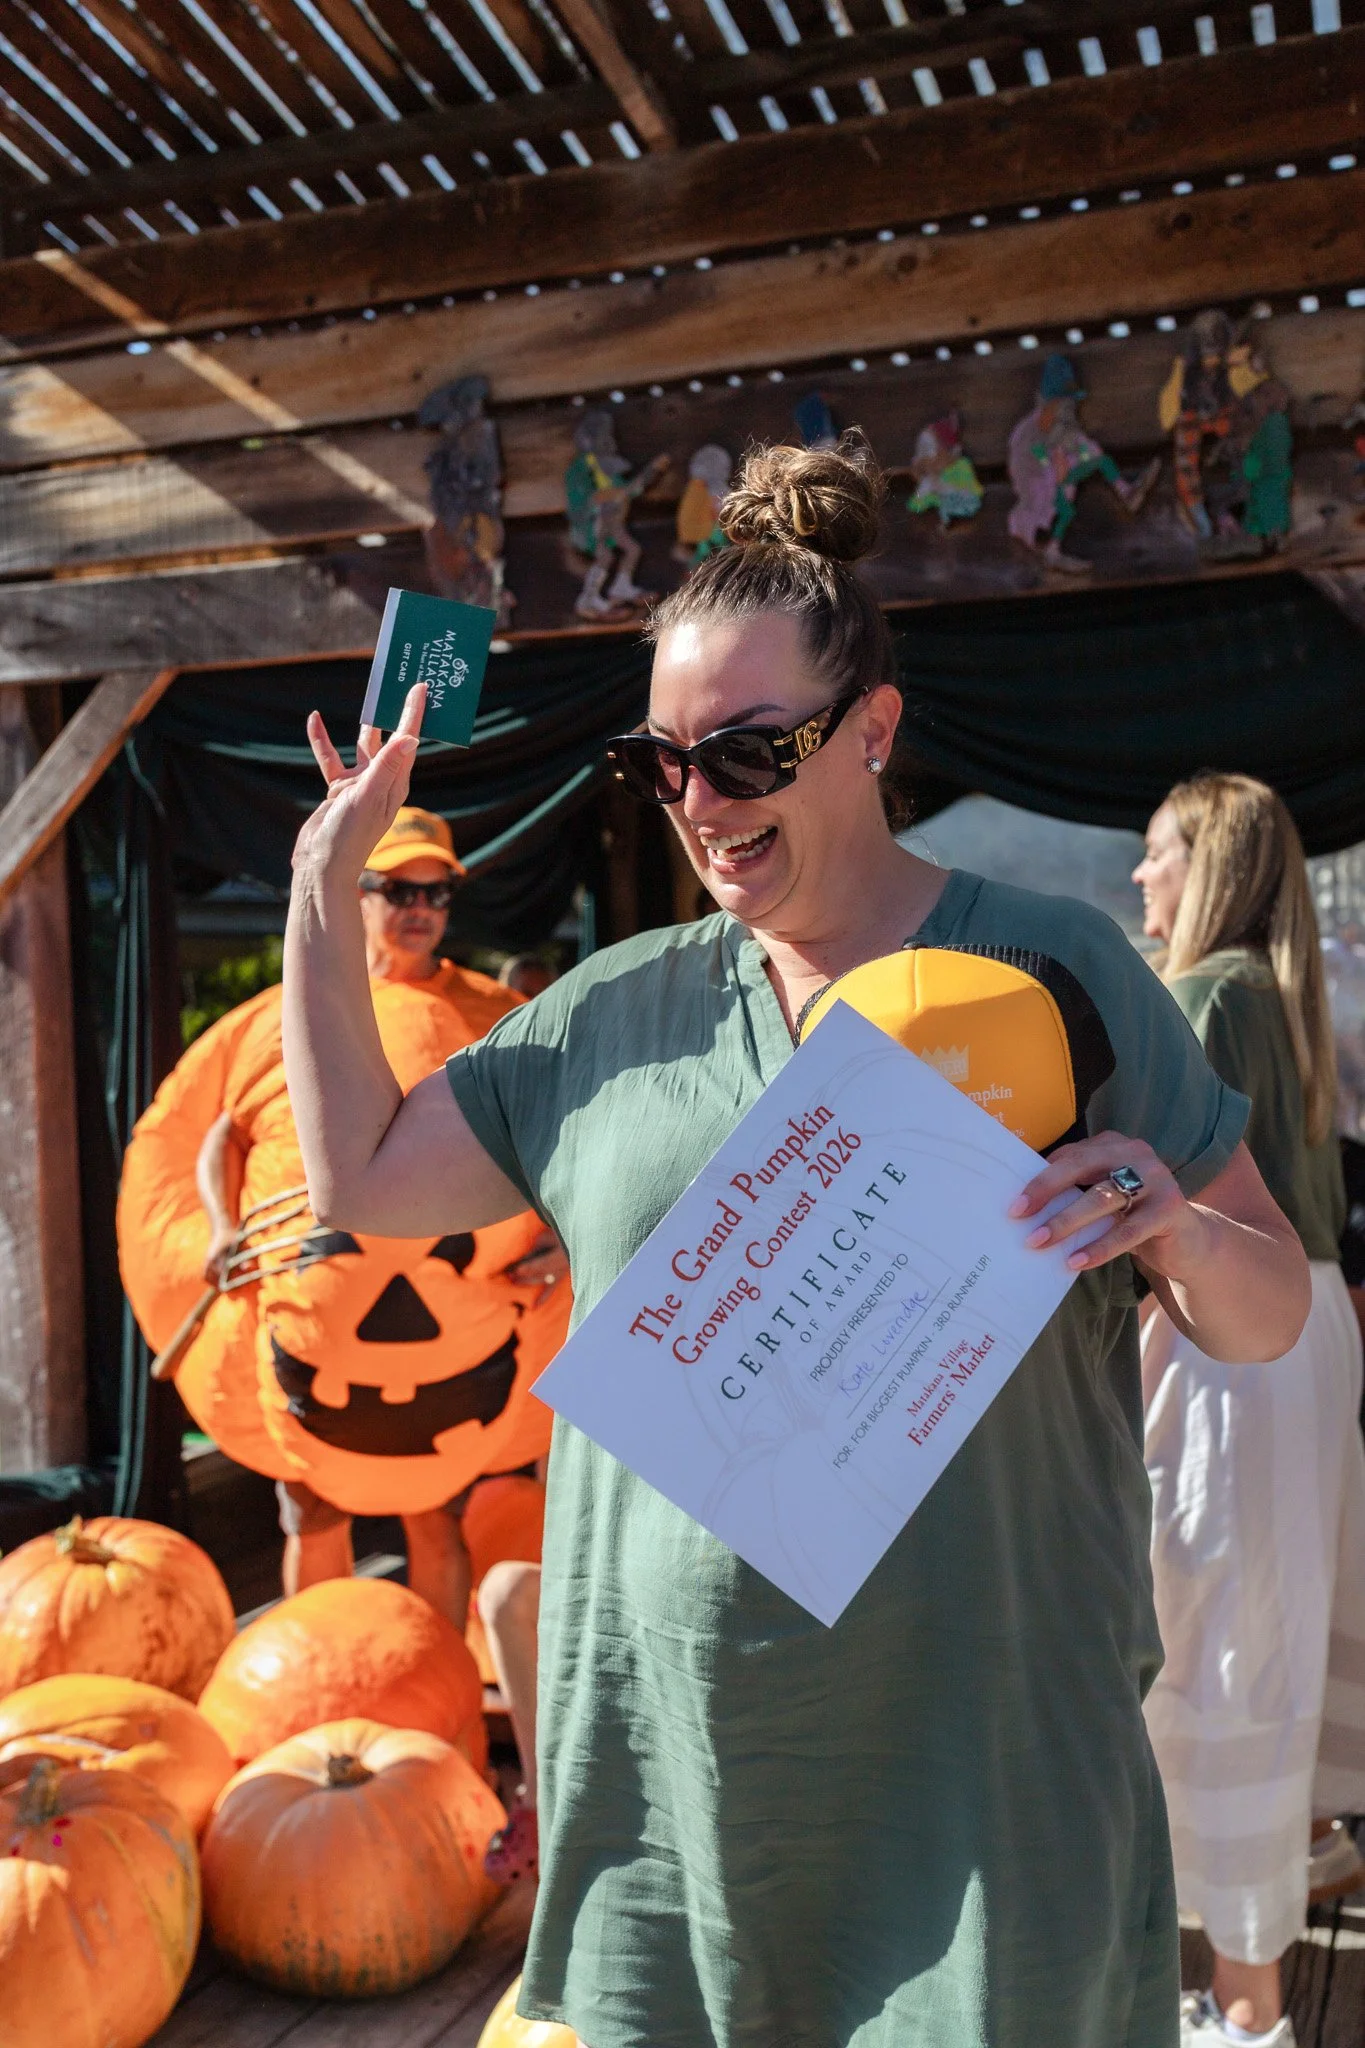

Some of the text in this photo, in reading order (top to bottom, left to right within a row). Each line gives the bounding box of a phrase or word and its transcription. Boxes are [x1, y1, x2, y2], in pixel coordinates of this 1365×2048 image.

[397, 642, 412, 682] GIFT CARD
[430, 629, 457, 709] MATAKANA
[629, 1105, 836, 1344] The Grand Pumpkin
[672, 1126, 862, 1365] Growing Contest 2026
[720, 1162, 907, 1400] CERTIFICATE
[799, 1251, 872, 1344] OF AWARD
[809, 1253, 909, 1383] PROUDLY PRESENTED TO
[832, 1444, 854, 1470] FOR:
[851, 1420, 871, 1445] FOR
[866, 1379, 902, 1423] BIGGEST
[896, 1336, 933, 1382] PUMPKIN
[933, 1310, 951, 1332] 3RD
[948, 1270, 980, 1312] RUNNER
[977, 1253, 992, 1273] UP!
[839, 1359, 875, 1399] Kate
[907, 1338, 970, 1418] Matakana Village
[907, 1333, 996, 1447] Farmers' Market
